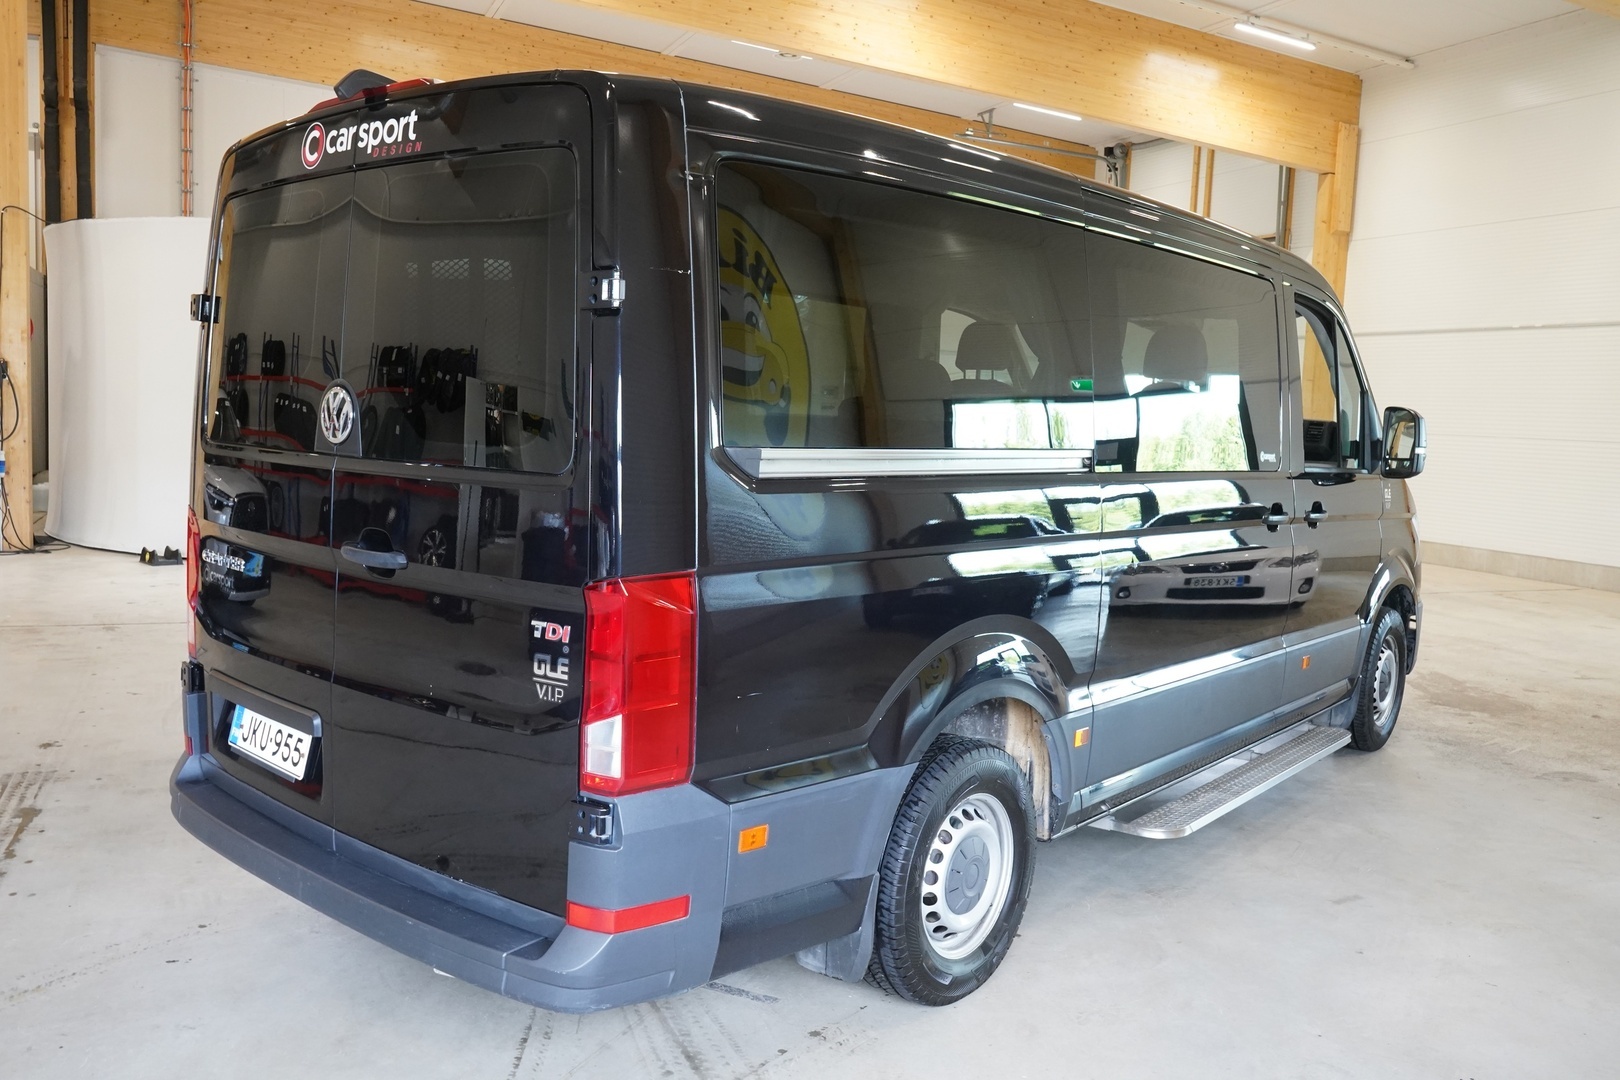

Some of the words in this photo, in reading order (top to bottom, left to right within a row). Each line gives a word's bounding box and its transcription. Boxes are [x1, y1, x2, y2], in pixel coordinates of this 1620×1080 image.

[372, 141, 423, 158] DESIGN
[530, 619, 571, 644] TDI
[533, 653, 569, 681] GLE
[535, 682, 565, 703] V.I.P.
[242, 716, 304, 767] JKU-955
